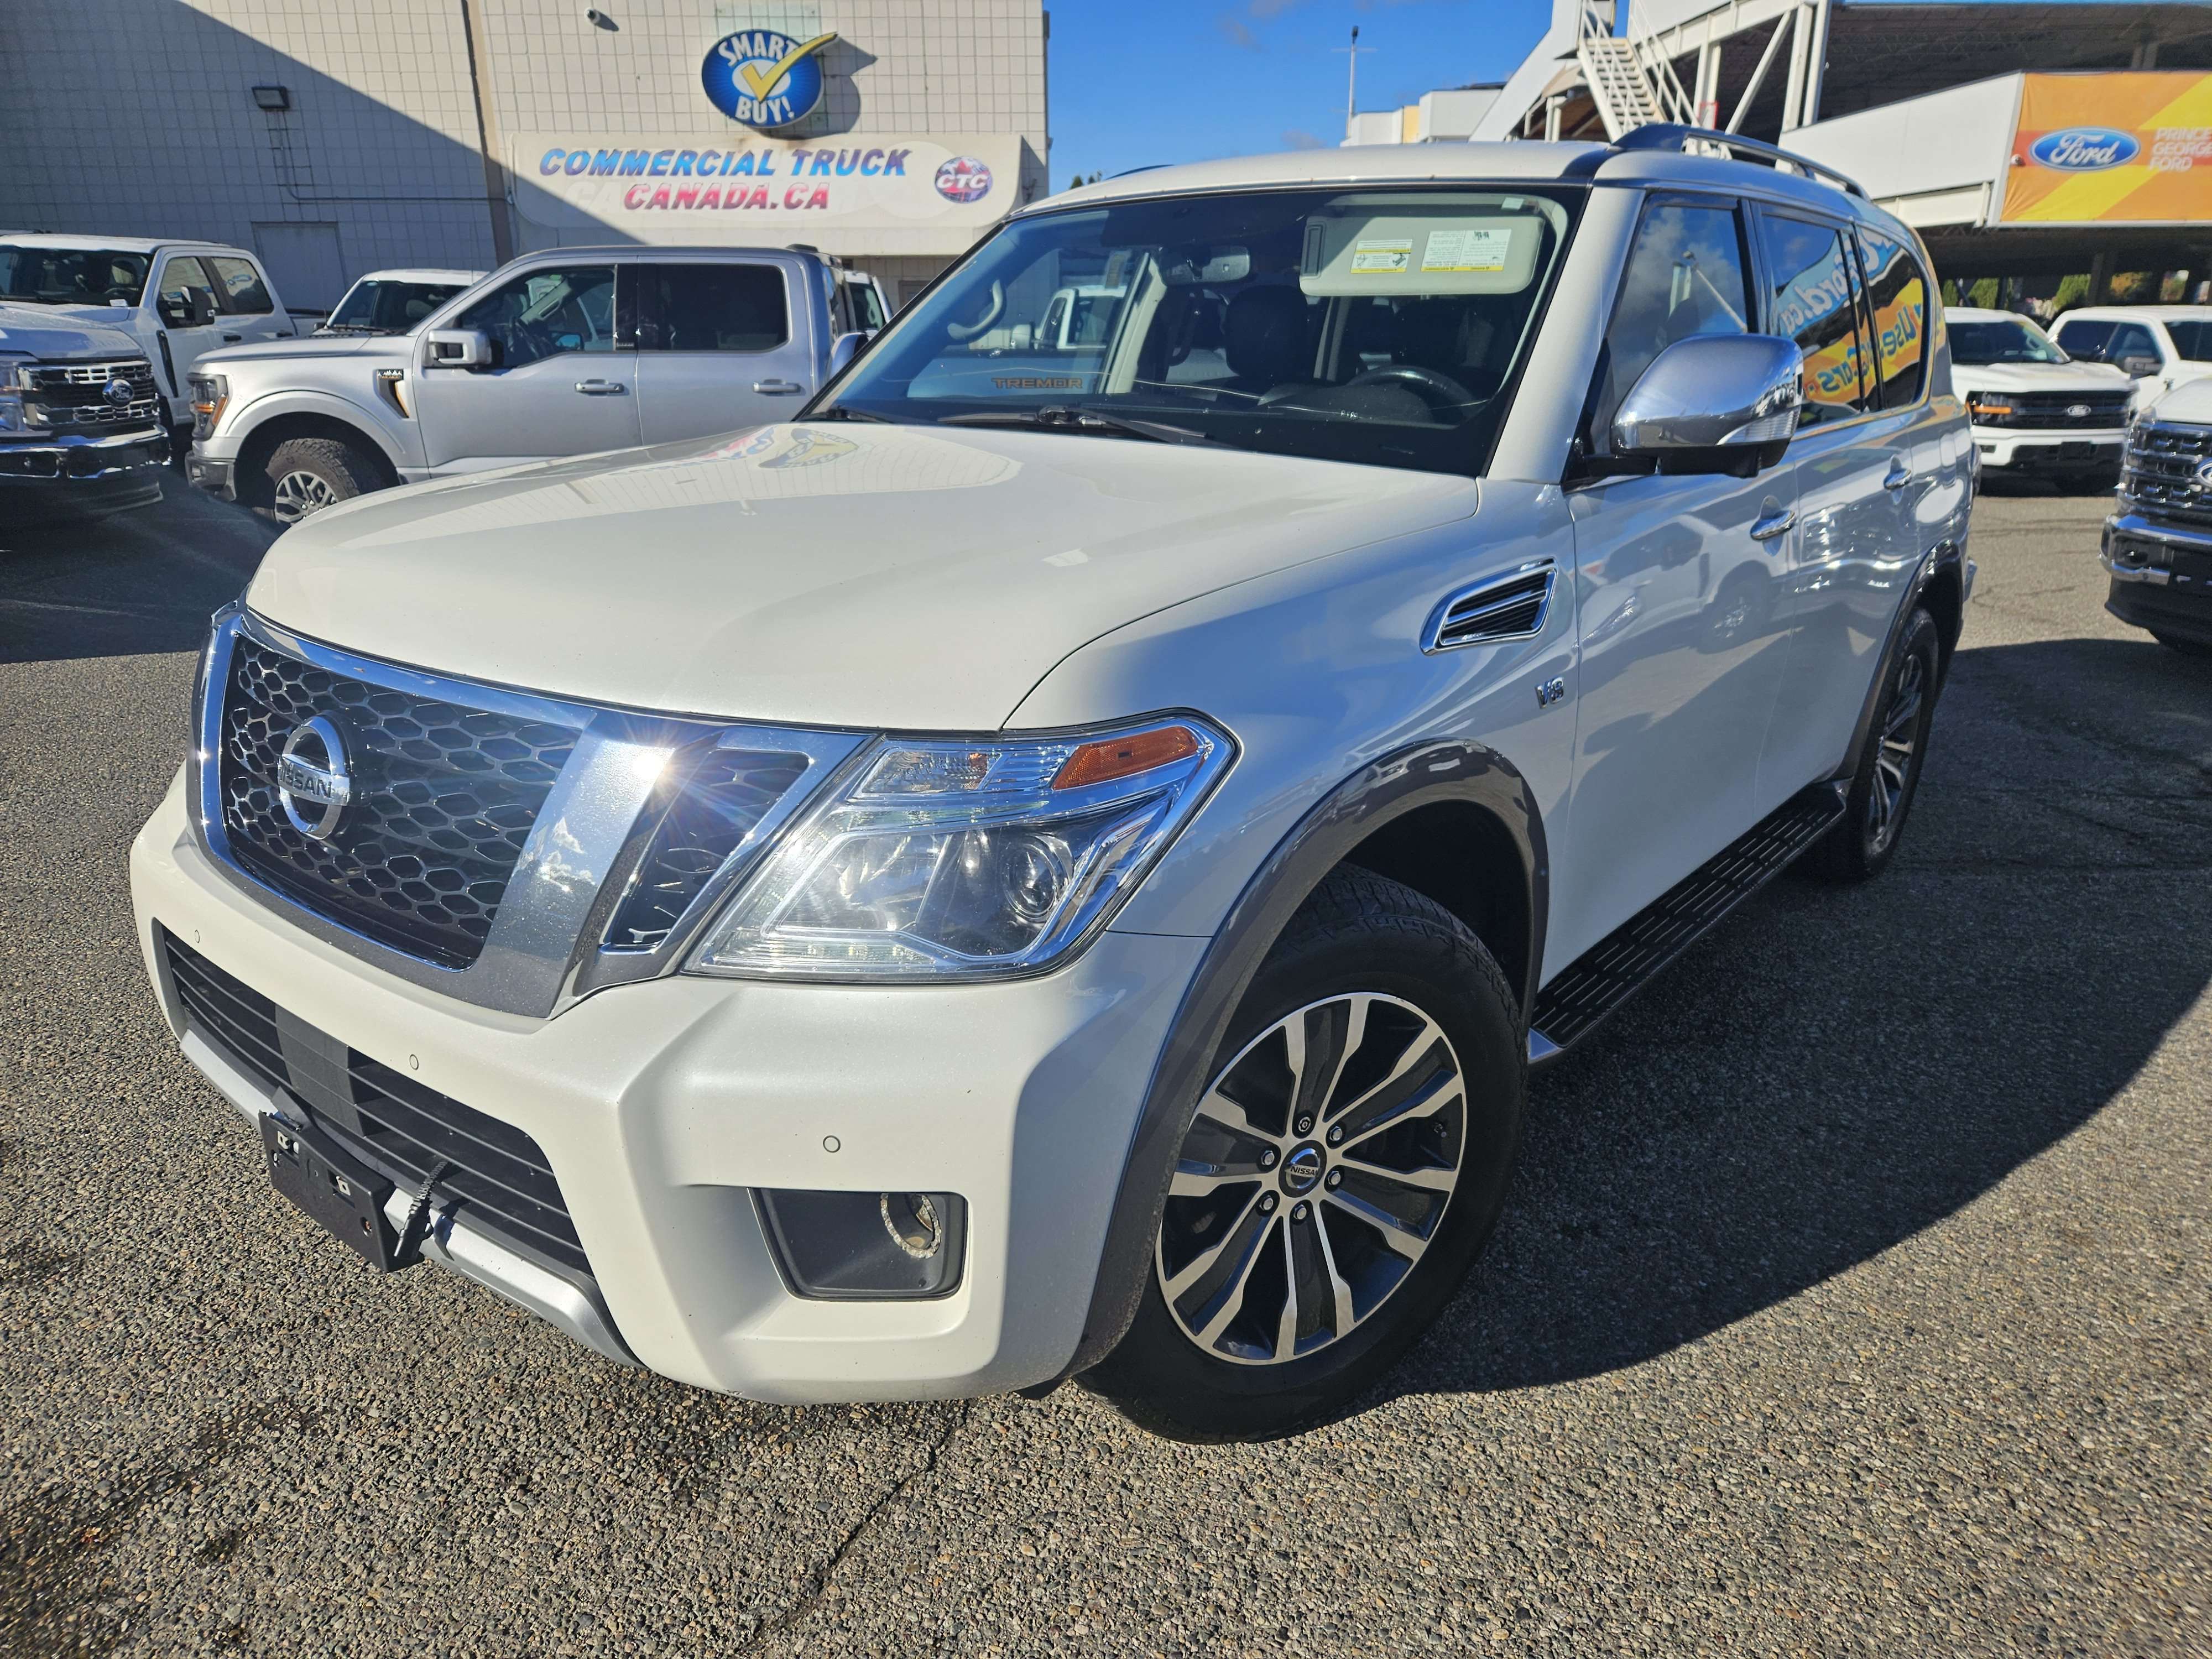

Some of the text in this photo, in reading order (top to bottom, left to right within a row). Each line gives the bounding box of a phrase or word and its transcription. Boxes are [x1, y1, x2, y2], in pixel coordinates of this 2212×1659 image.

[718, 33, 799, 67] SMART
[735, 95, 795, 124] BUY!
[539, 148, 912, 176] COMMERCIAL TRUCK
[2050, 133, 2121, 165] Ford
[2150, 156, 2193, 172] FORD
[937, 174, 988, 189] CTC
[623, 182, 830, 210] CANADA.CA
[991, 378, 1083, 389] TREMOR
[1535, 676, 1564, 709] V8
[278, 762, 332, 798] NISSAN
